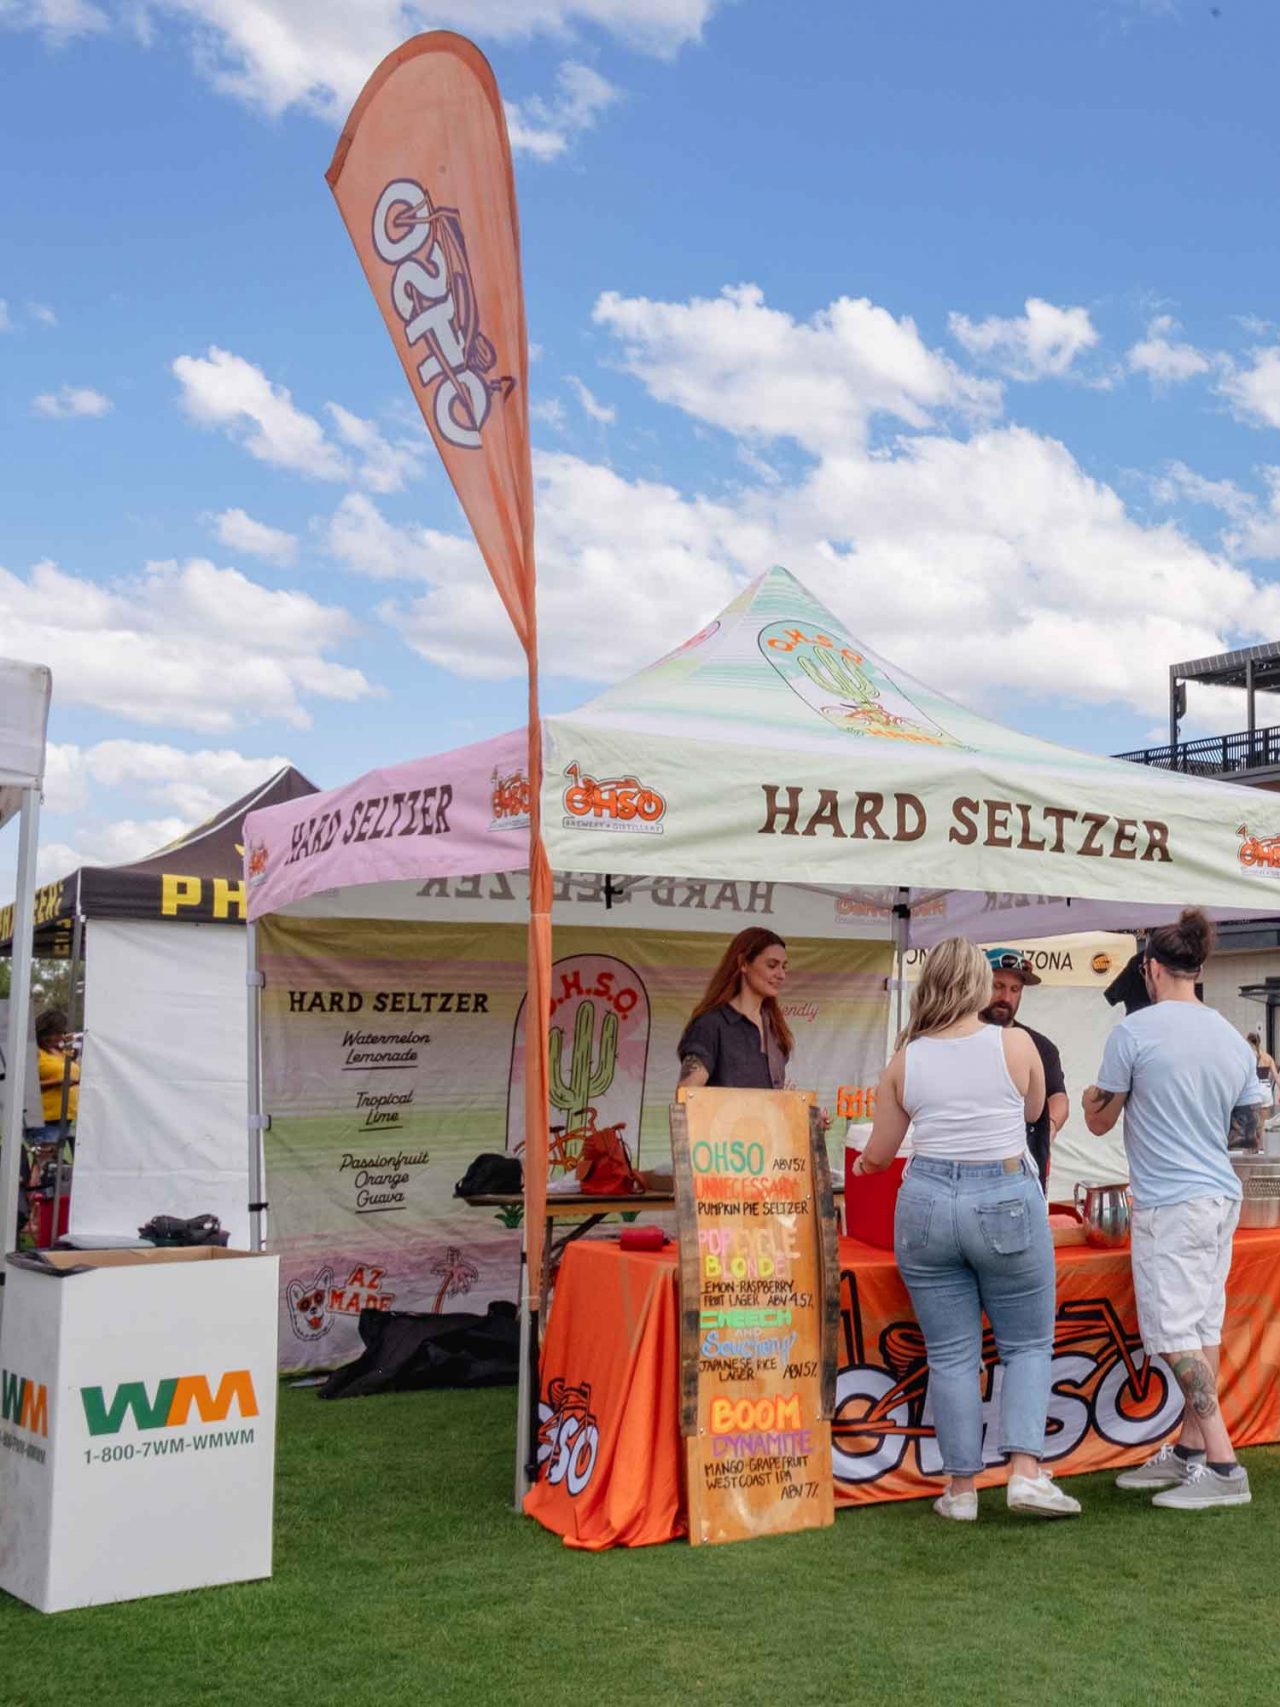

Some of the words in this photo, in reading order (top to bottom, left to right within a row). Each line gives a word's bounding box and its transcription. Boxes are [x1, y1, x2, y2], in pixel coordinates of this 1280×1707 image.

[565, 785, 665, 823] OHSO
[284, 808, 342, 866] HARD
[342, 784, 453, 845] SELTZER
[758, 784, 927, 841] HARD
[948, 796, 1173, 863] SELTZER
[289, 991, 363, 1012] HARD
[372, 992, 489, 1013] SELTZER
[342, 1030, 432, 1047] Watermelon
[345, 1049, 418, 1066] Lemonade
[356, 1090, 414, 1109] Tropical
[364, 1109, 399, 1126] Lime
[339, 1151, 430, 1173] Passionfruit
[692, 1140, 765, 1175] OHSO
[353, 1170, 410, 1190] Orange
[355, 1190, 405, 1208] Guava
[697, 1201, 741, 1216] PUMPKIN
[742, 1202, 760, 1216] PIE
[762, 1201, 809, 1216] SELTZER
[704, 1253, 787, 1280] BLONDE
[348, 1267, 386, 1290] AZ
[329, 1289, 395, 1315] MADE
[729, 1294, 760, 1307] LAGER
[699, 1358, 752, 1373] JAPANESE
[719, 1369, 755, 1382] LAGER
[2, 1369, 48, 1441] WM
[80, 1369, 260, 1437] WM
[709, 1392, 802, 1434] BOOM
[83, 1428, 255, 1465] 1-800-7WM-WMWM
[713, 1430, 813, 1458] DYNAMITE
